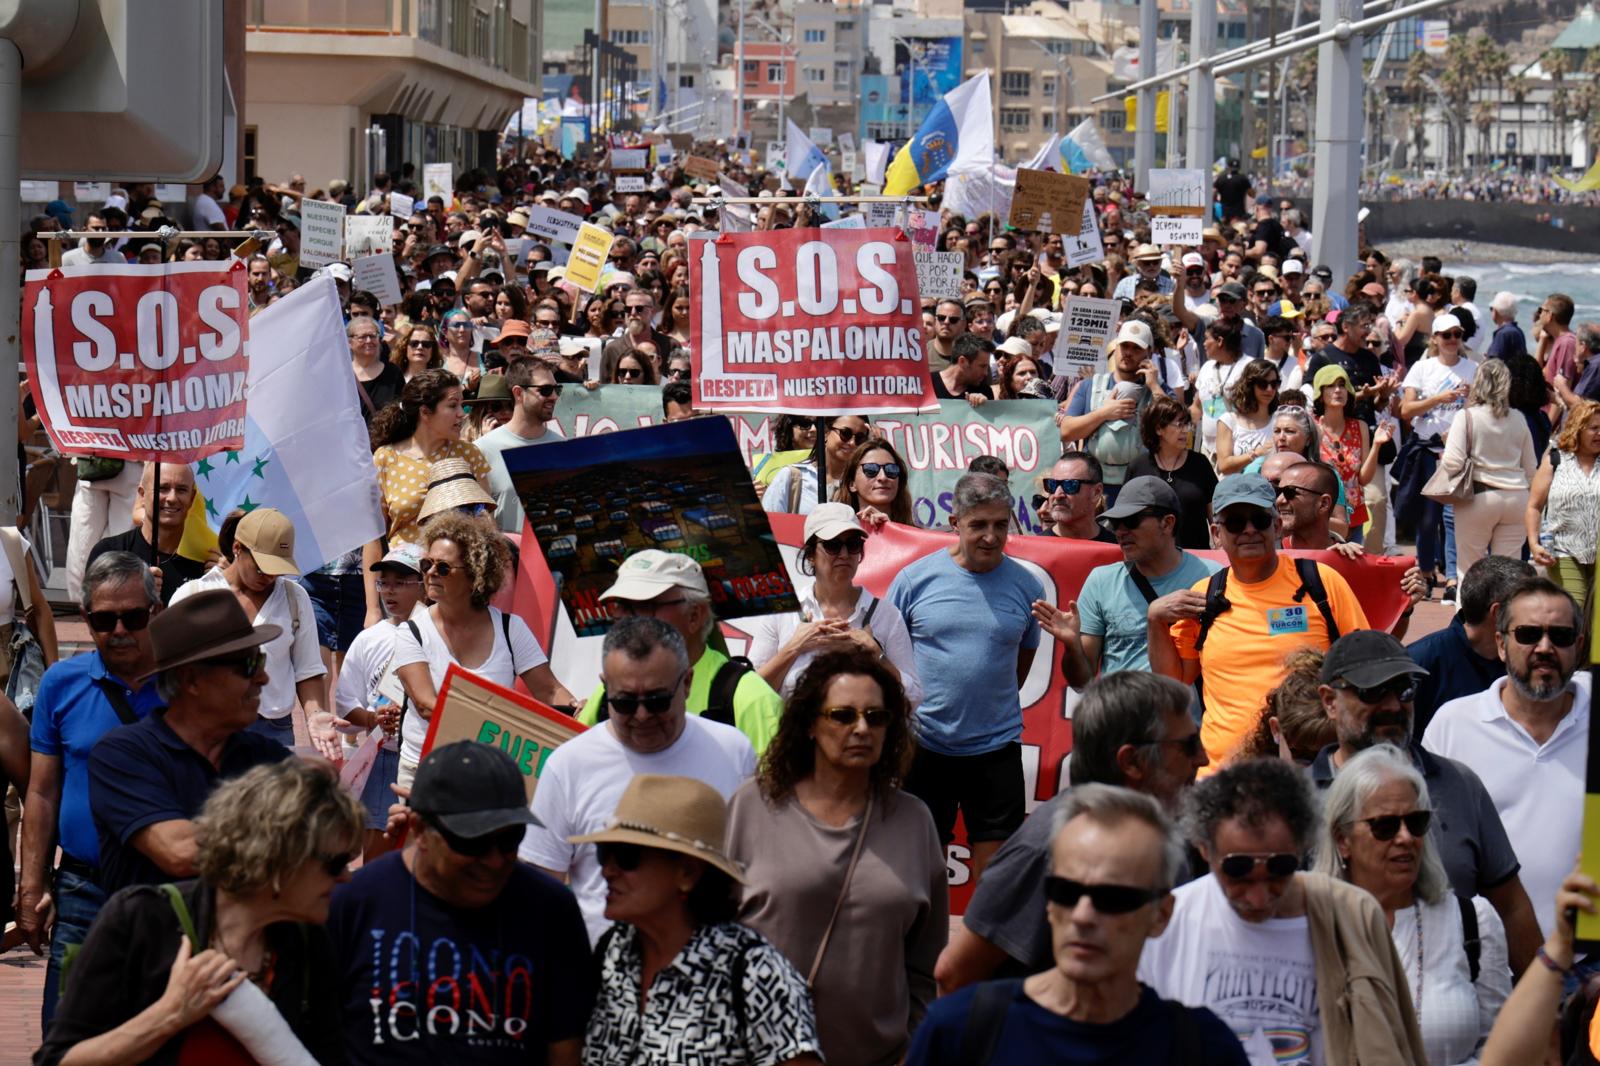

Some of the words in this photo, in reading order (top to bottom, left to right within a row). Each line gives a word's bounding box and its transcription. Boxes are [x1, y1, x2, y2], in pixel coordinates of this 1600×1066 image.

[306, 213, 338, 223] NUESTRAS
[307, 225, 336, 235] ESPECIES
[915, 251, 934, 264] QUE
[938, 251, 962, 264] HAGO
[929, 265, 948, 276] POR
[736, 241, 913, 319] S.O.S.
[930, 278, 948, 289] POR
[1071, 317, 1109, 329] 129MIL
[727, 327, 922, 363] MASPALOMAS
[703, 378, 775, 398] RESPETA
[784, 377, 857, 396] NUESTRO
[861, 376, 923, 396] LITORAL
[60, 429, 123, 448] RESPETA
[127, 430, 200, 451] NUESTRO
[204, 418, 245, 446] LITORA
[875, 420, 1040, 472] TURISMO
[1286, 607, 1303, 616] 30
[369, 998, 527, 1044] ICONO
